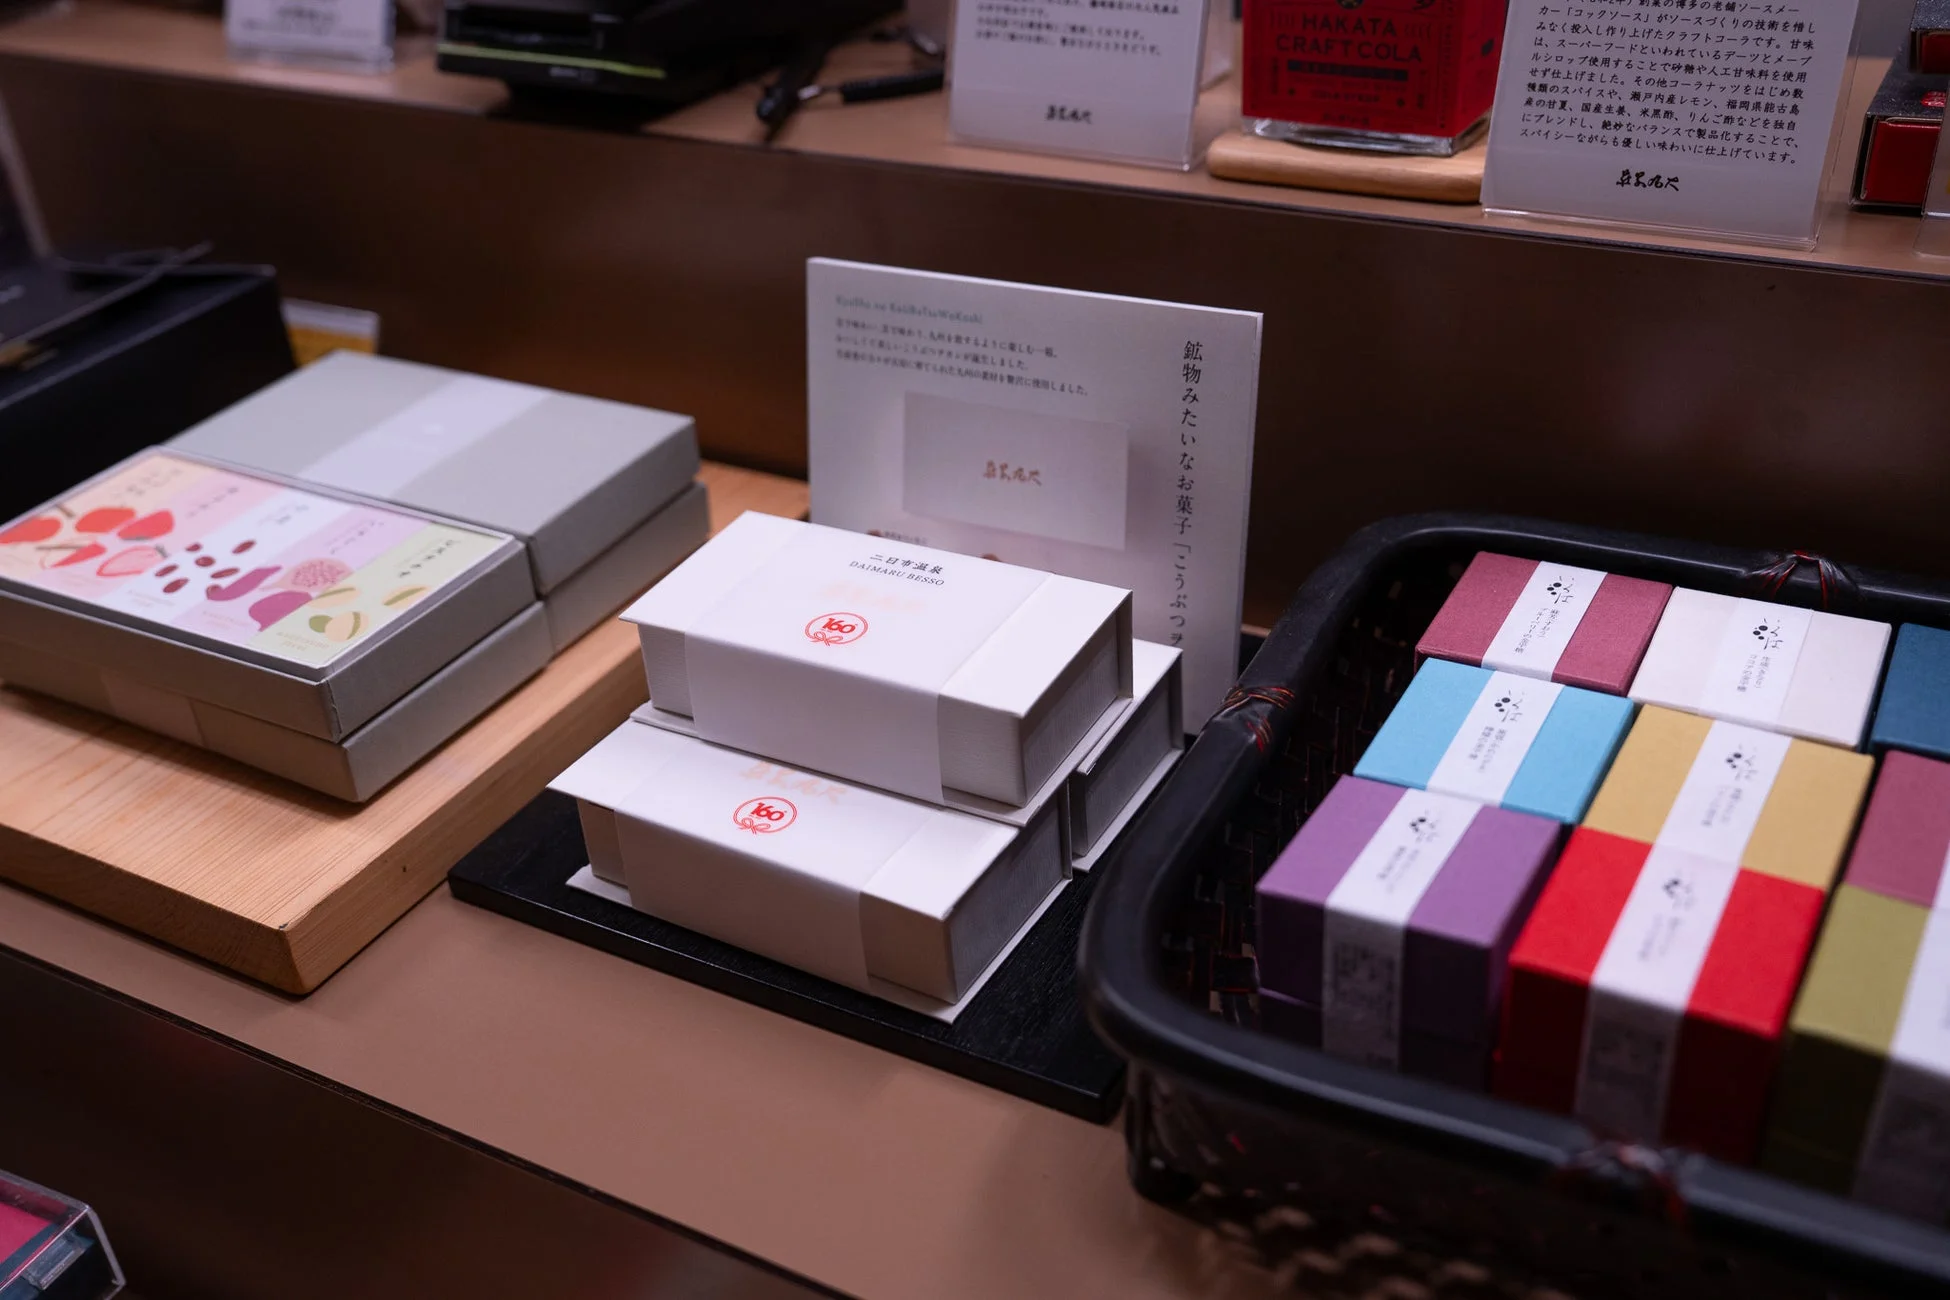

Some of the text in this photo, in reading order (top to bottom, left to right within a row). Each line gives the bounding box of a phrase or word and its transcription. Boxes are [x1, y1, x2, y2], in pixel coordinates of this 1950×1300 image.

[1303, 13, 1397, 37] HAKATA
[849, 560, 945, 587] DAIMARU BESSO
[869, 553, 943, 575] 二日市温泉
